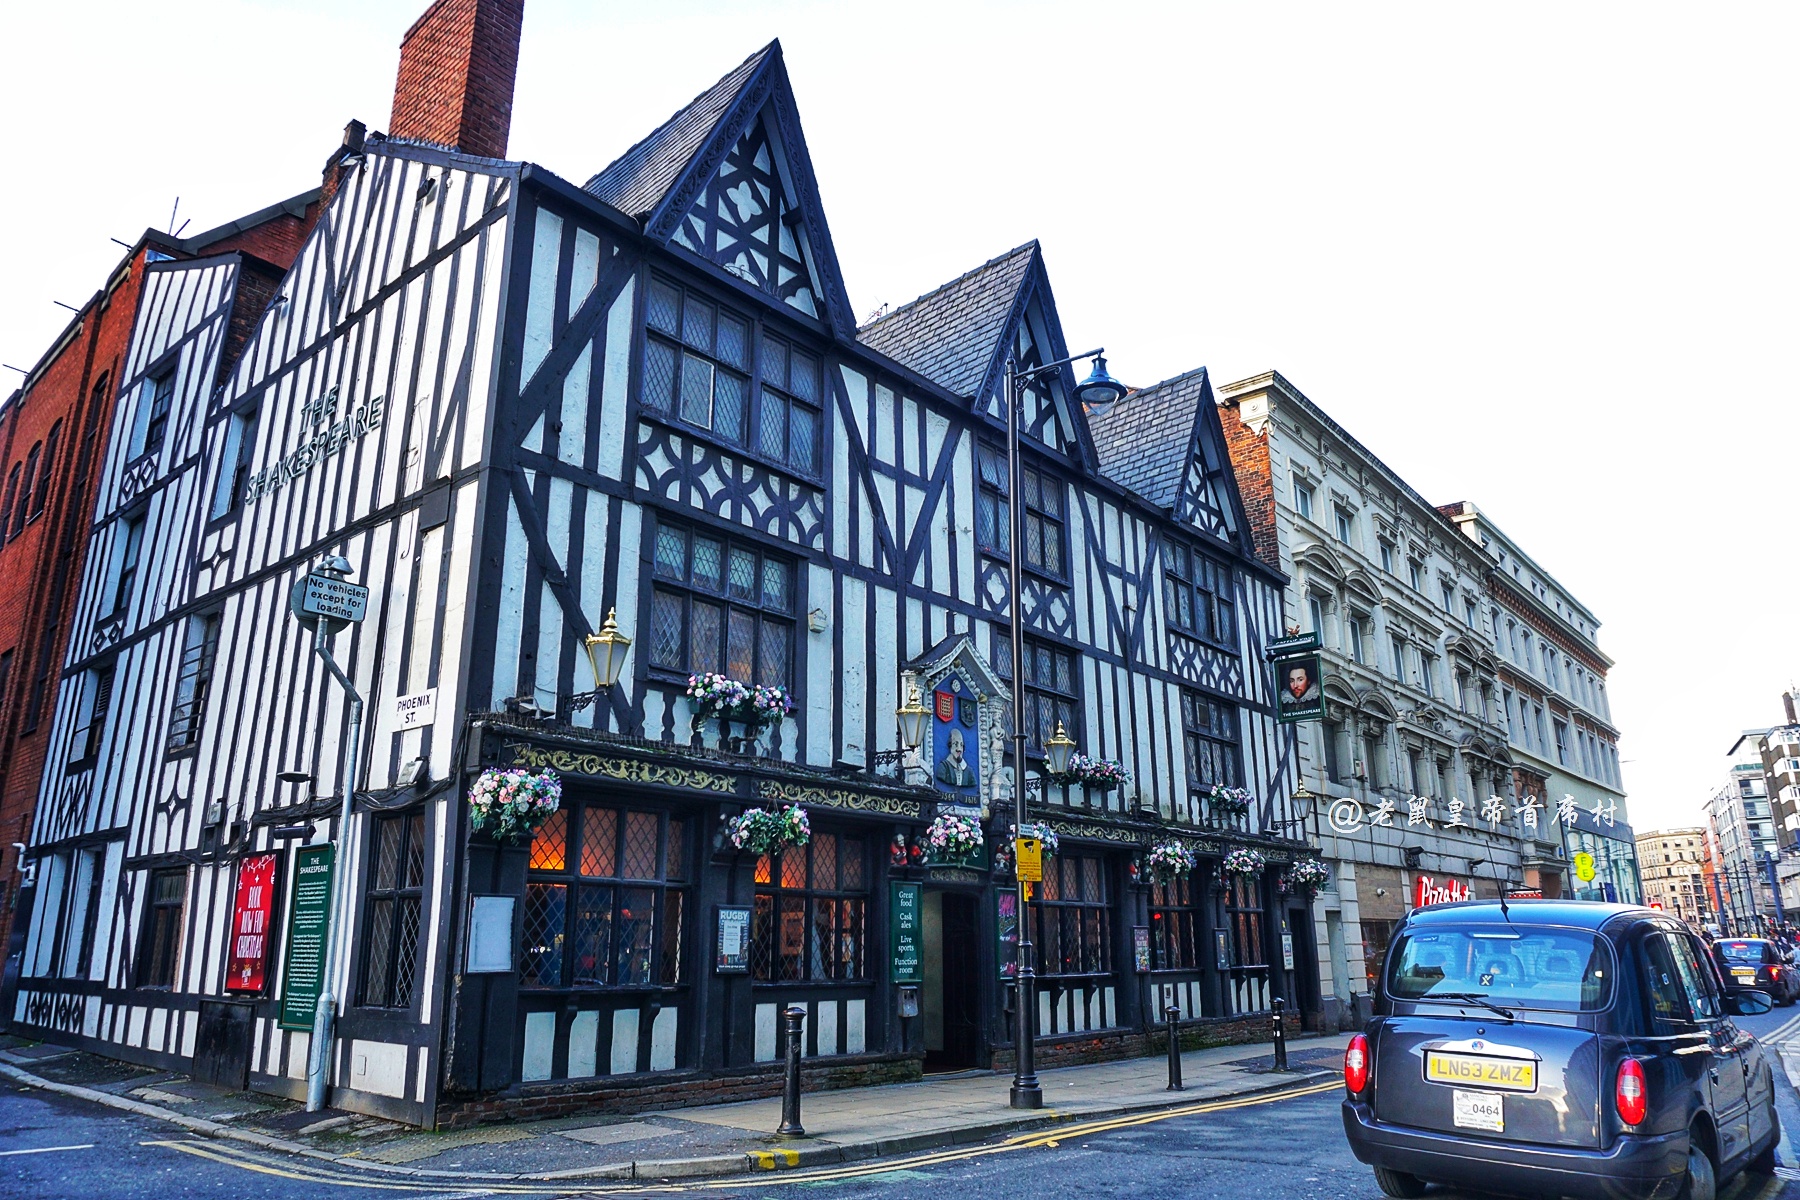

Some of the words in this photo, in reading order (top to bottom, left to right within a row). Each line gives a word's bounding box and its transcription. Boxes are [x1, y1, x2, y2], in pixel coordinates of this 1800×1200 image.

[300, 384, 339, 435] THE
[245, 394, 384, 505] SHAKESPEARE
[309, 577, 324, 588] No
[327, 583, 367, 599] vehicles
[311, 591, 345, 605] except
[347, 597, 362, 609] for
[317, 602, 353, 618] loading
[397, 693, 431, 712] PHOENIX
[405, 711, 416, 724] ST.
[1292, 708, 1321, 717] SHAKESPEARE
[310, 857, 320, 865] THE
[299, 864, 329, 875] SHAKESPEARE
[898, 890, 914, 899] Great
[1418, 876, 1451, 906] Pizza
[900, 898, 912, 907] food
[720, 910, 749, 920] RUGBY
[899, 912, 913, 921] Cask
[900, 921, 911, 929] ales
[900, 935, 912, 943] Live
[898, 944, 914, 953] sports
[894, 957, 918, 966] Function
[898, 966, 914, 974] room
[1437, 1058, 1483, 1078] LN63
[1488, 1063, 1523, 1082] ZMZ
[1472, 1103, 1500, 1116] 0464
